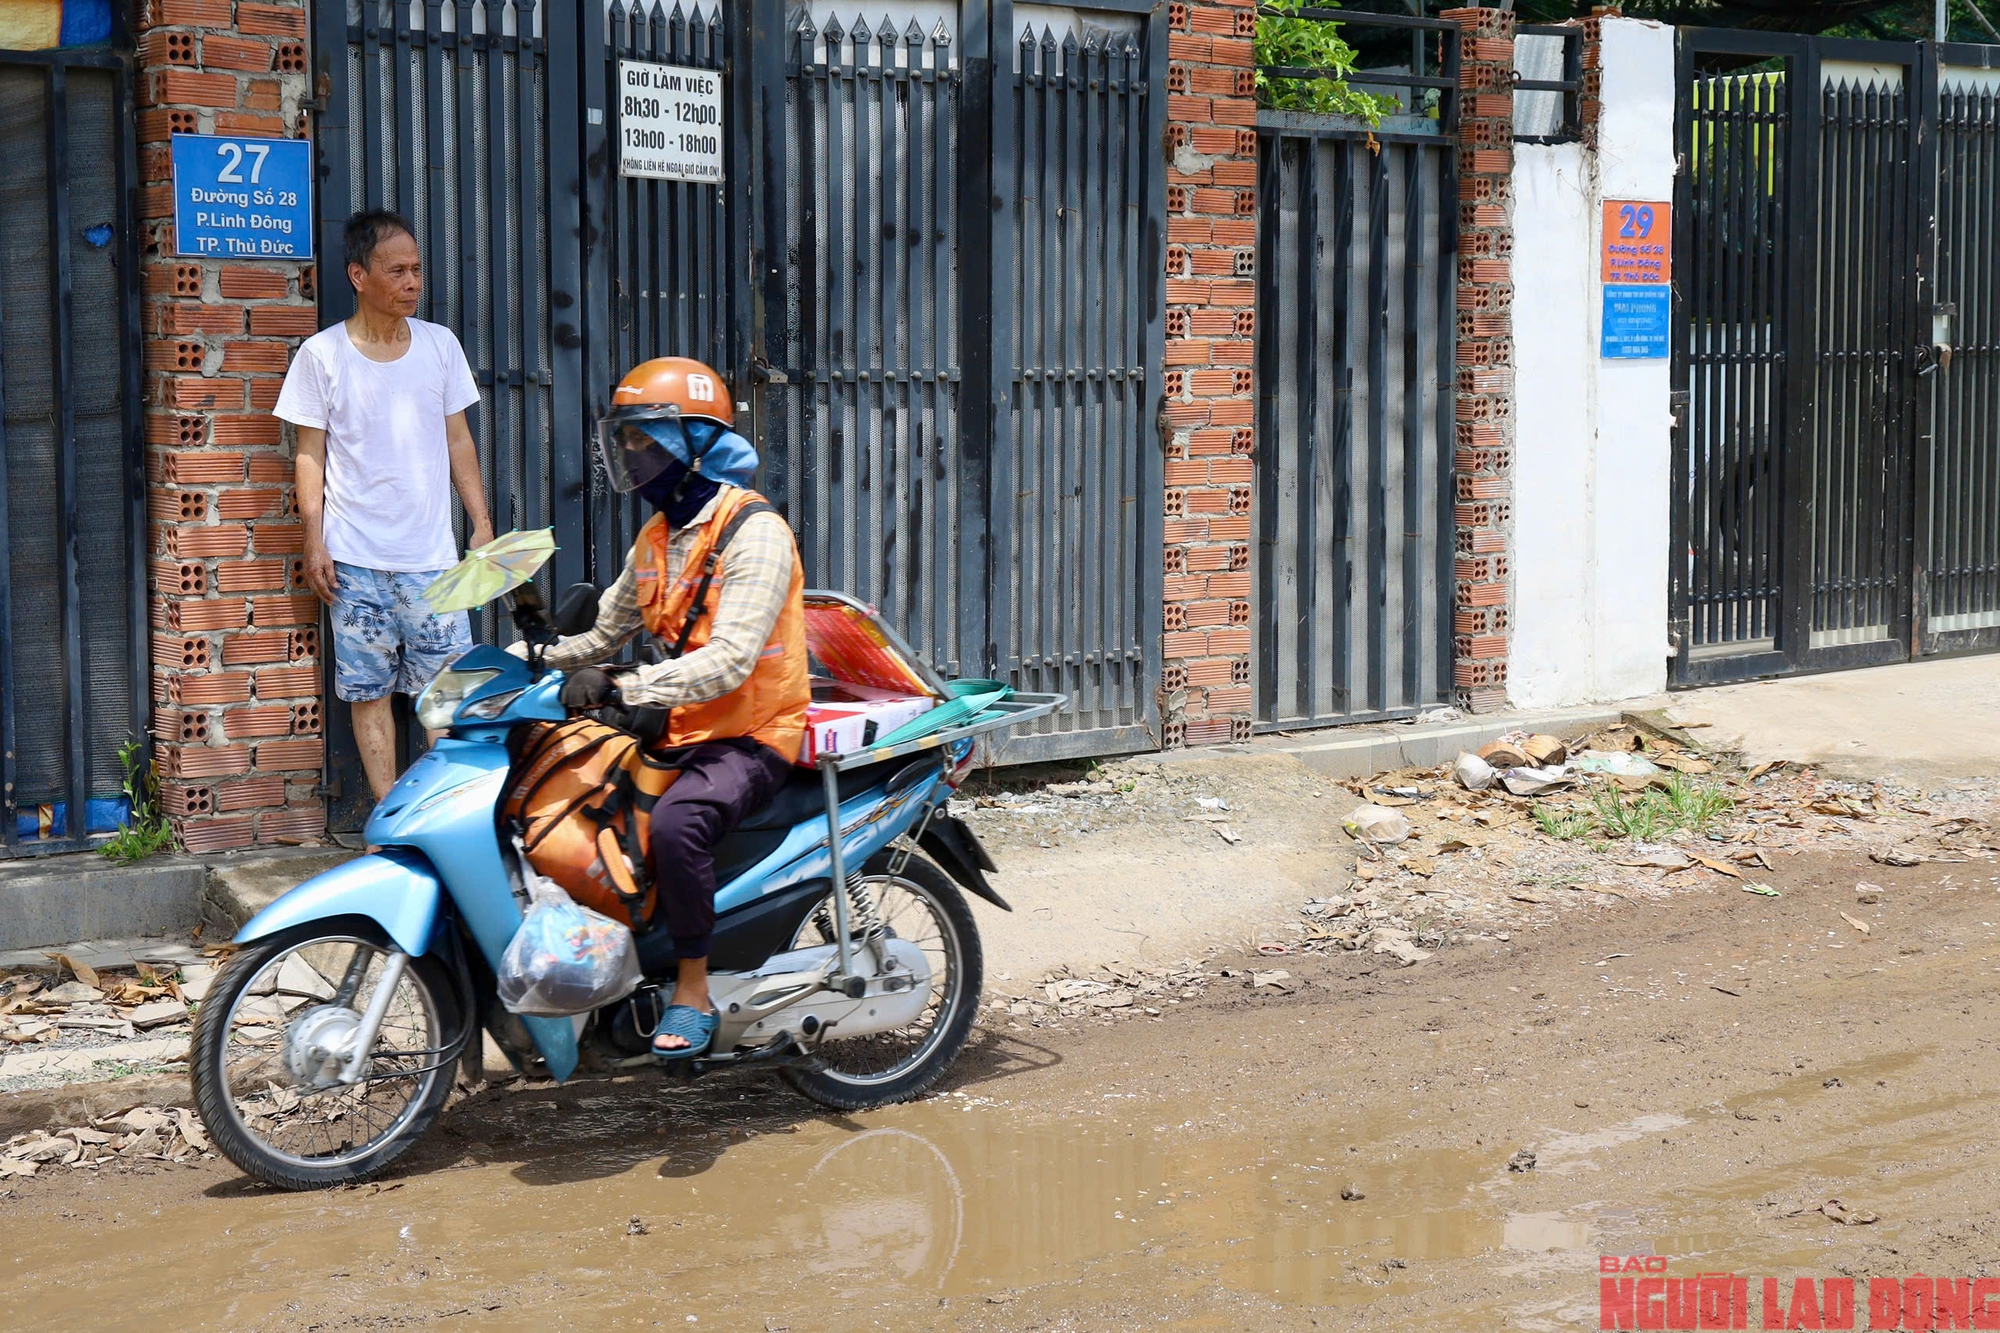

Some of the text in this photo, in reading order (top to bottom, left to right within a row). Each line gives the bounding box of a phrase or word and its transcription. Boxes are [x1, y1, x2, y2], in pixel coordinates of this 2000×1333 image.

[627, 68, 713, 97] GIỜ LÀM VIỆC
[624, 95, 660, 119] 8h30
[674, 101, 716, 125] 12h00
[625, 127, 665, 150] 13h00
[678, 133, 717, 155] 18h00
[217, 142, 270, 184] 27
[622, 157, 643, 170] KHÔNG
[191, 187, 297, 208] Đường Số 28
[196, 212, 292, 234] P.Linh Đông
[1619, 203, 1654, 238] 29
[196, 234, 294, 254] TP. Thủ Đức
